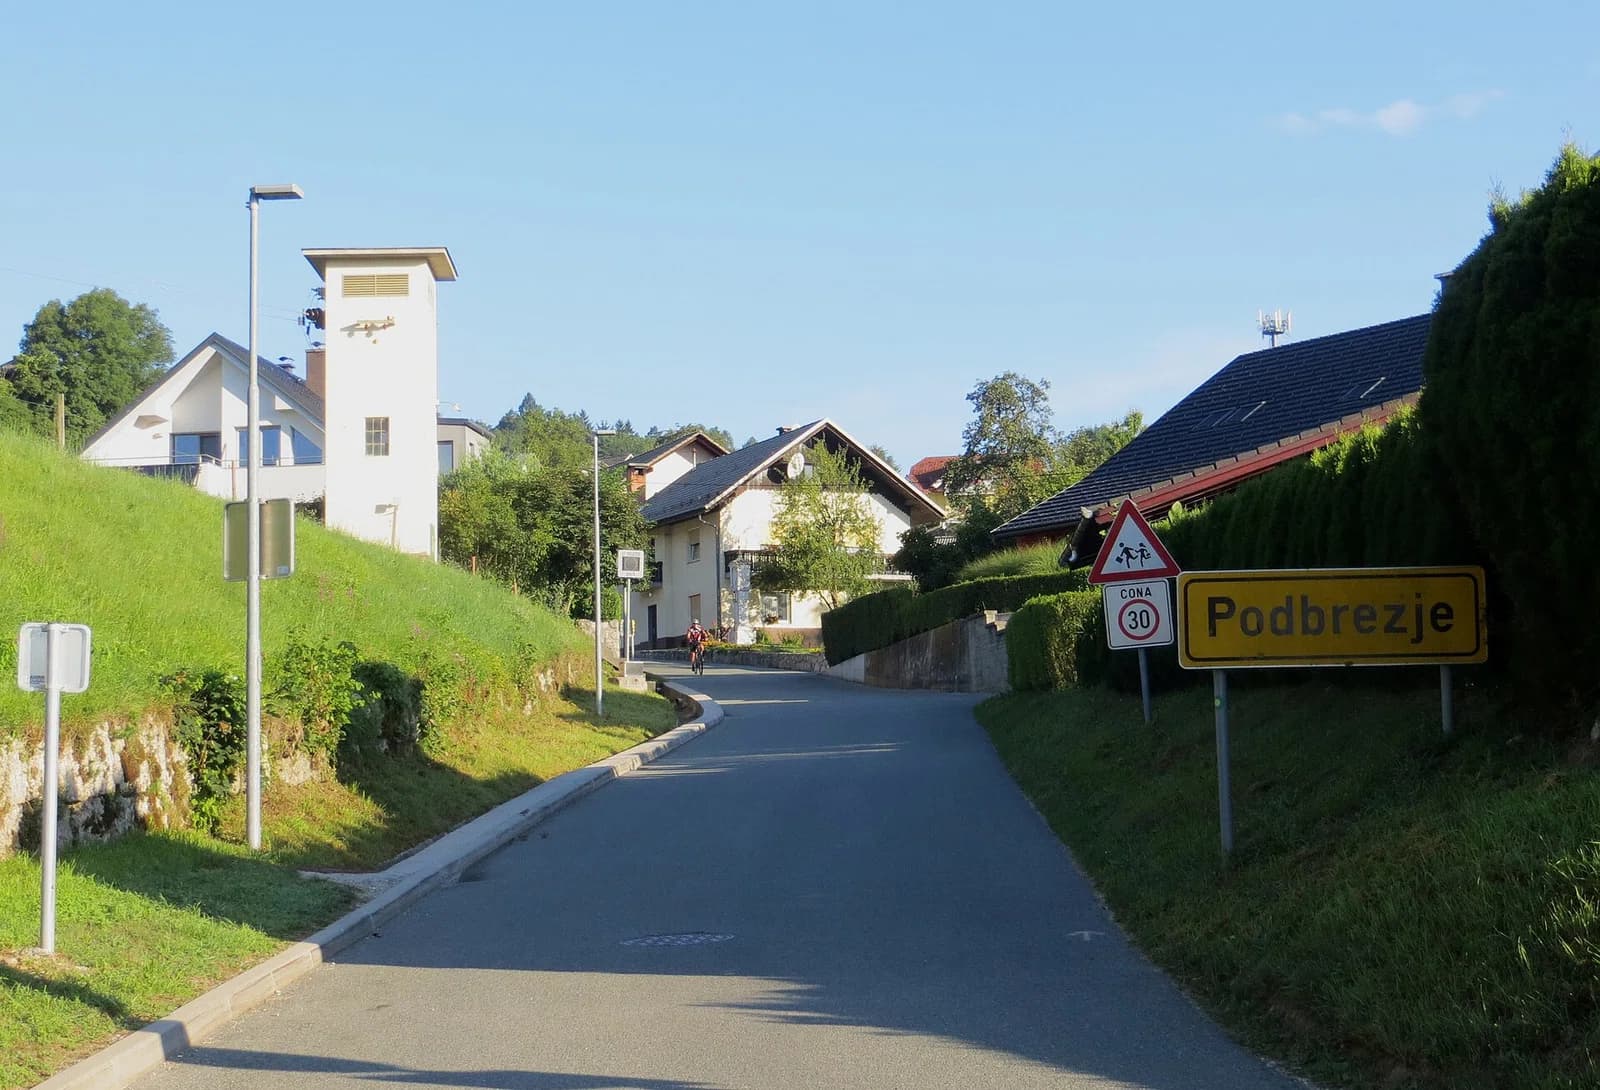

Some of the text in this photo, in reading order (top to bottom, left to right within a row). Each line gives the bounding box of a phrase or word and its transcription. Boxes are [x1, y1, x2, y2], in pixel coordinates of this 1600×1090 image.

[1120, 587, 1152, 599] CONA
[1127, 609, 1150, 630] 30
[1207, 592, 1454, 644] Podbrezje
